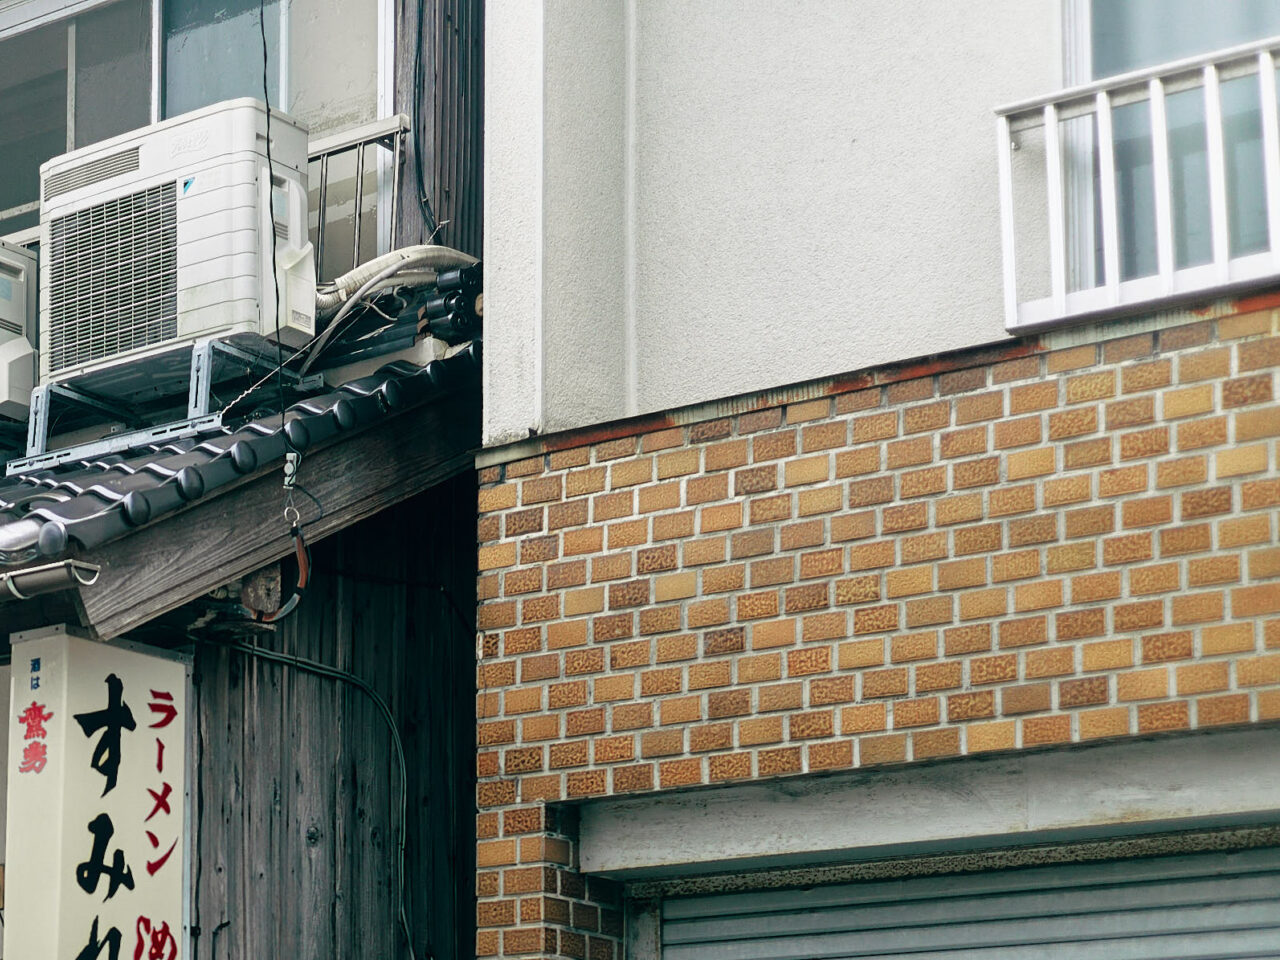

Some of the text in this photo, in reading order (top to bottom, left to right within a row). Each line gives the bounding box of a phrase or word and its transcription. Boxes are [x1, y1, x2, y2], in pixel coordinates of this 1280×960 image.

[29, 657, 41, 690] 酒は
[144, 688, 178, 877] ラーメン
